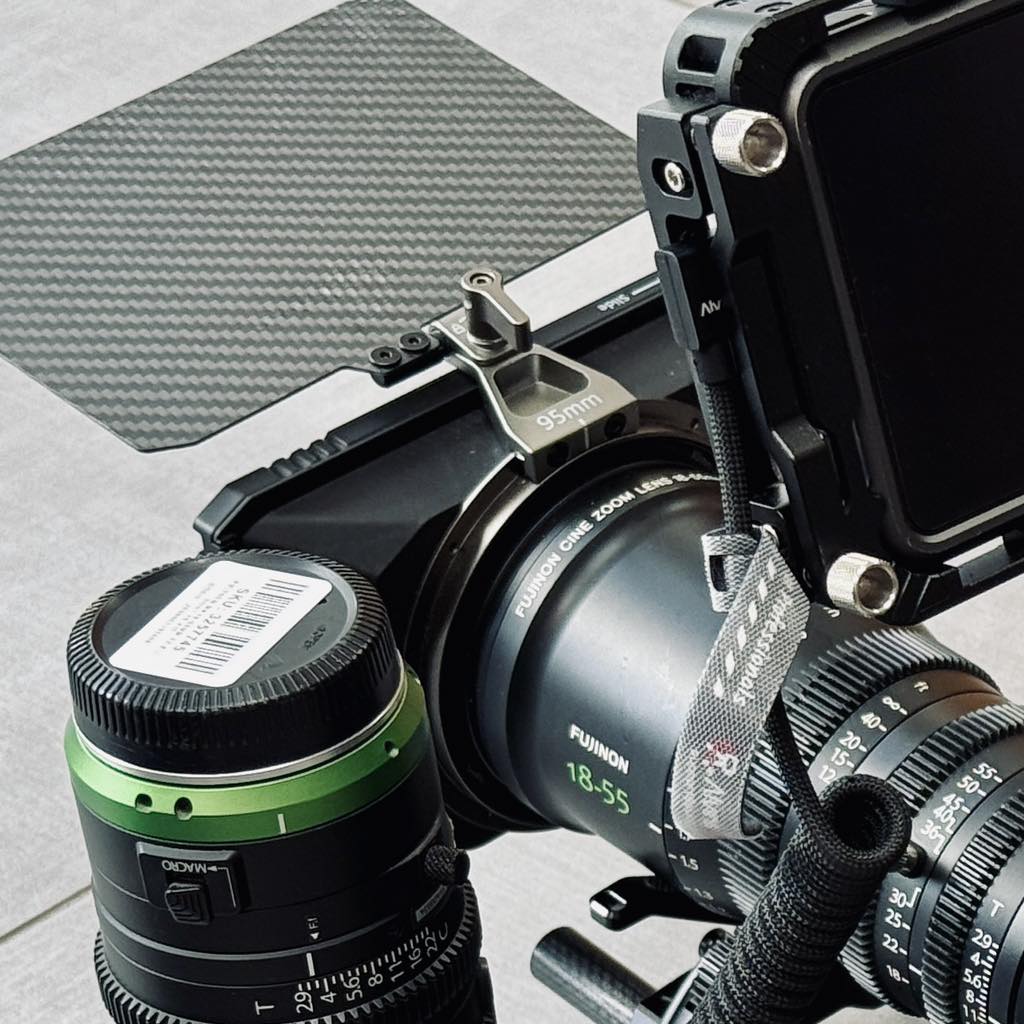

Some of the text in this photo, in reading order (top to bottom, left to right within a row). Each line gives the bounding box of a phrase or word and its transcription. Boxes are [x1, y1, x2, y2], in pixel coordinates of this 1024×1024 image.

[597, 293, 631, 312] Slide
[536, 392, 603, 431] 95mm
[515, 552, 561, 618] FUJINON
[559, 519, 595, 552] CINE
[591, 490, 636, 522] ZOOM
[634, 476, 674, 495] LENS
[861, 712, 881, 729] 40
[569, 723, 630, 774] FUJINON
[839, 730, 861, 750] 20
[831, 747, 850, 766] 15
[819, 765, 836, 784] 12
[972, 763, 998, 779] 55
[566, 762, 630, 814] 18-55
[957, 775, 979, 793] 50
[942, 793, 965, 811] 45
[933, 805, 954, 823] 40
[161, 859, 207, 875] MACRO
[888, 888, 906, 908] 30
[992, 899, 1005, 917] T
[884, 909, 902, 928] 25
[425, 932, 438, 957] 22
[882, 933, 900, 953] 22
[409, 948, 424, 969] 16
[970, 952, 982, 966] 4
[368, 974, 383, 987] 8
[389, 960, 404, 983] 11
[886, 965, 901, 982] 18
[963, 968, 982, 989] 5.6
[320, 992, 337, 1004] 4
[344, 976, 363, 1001] 5.6
[965, 989, 975, 1004] 8
[255, 1001, 275, 1015] T
[962, 1004, 978, 1022] 11
